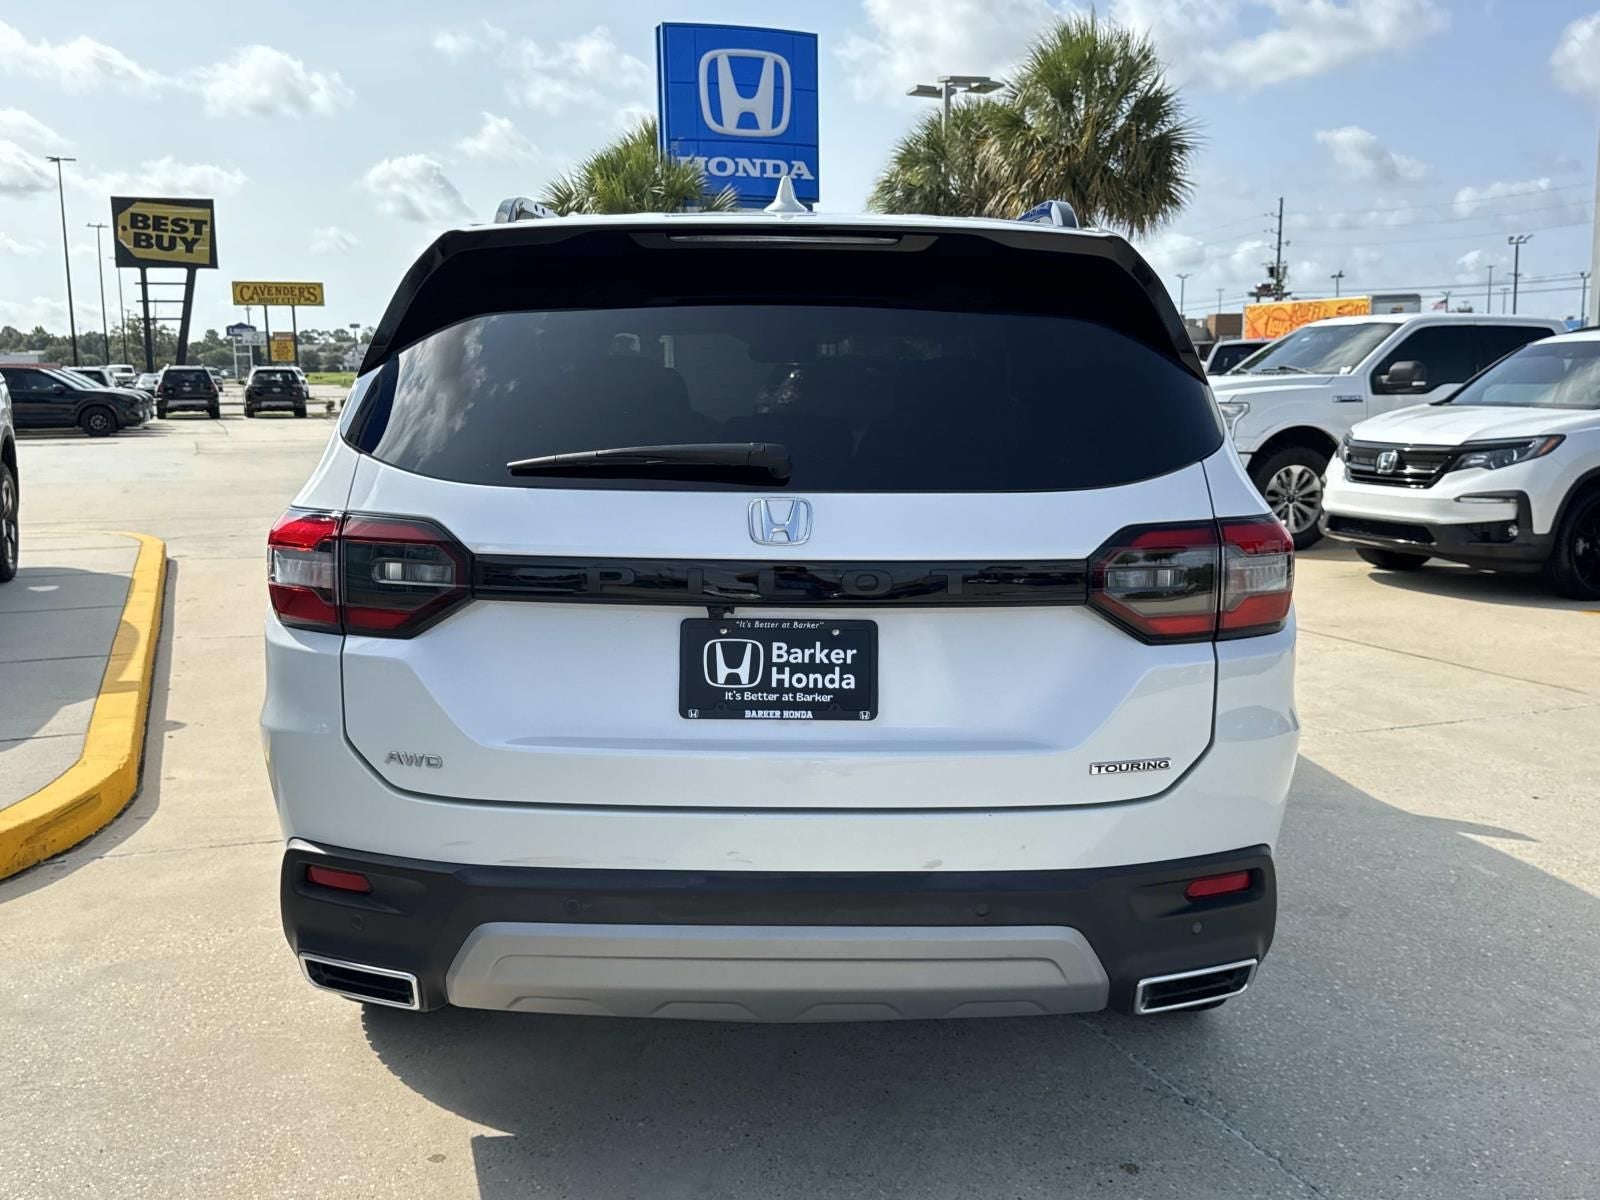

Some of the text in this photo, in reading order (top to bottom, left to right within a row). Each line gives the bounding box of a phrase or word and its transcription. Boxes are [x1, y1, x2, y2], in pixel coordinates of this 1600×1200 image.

[677, 155, 815, 180] HONDA
[130, 212, 208, 236] BEST
[133, 231, 202, 254] BUY
[240, 284, 318, 303] CAVENDER'S
[586, 566, 979, 600] PILOT
[754, 620, 779, 629] Better
[781, 621, 790, 629] at
[771, 641, 857, 664] Barker
[771, 666, 856, 690] Honda
[725, 690, 834, 702] It's Better at Barker
[744, 709, 814, 719] BARKER HONDA
[384, 751, 443, 769] AWD
[1094, 760, 1170, 774] TOURING
